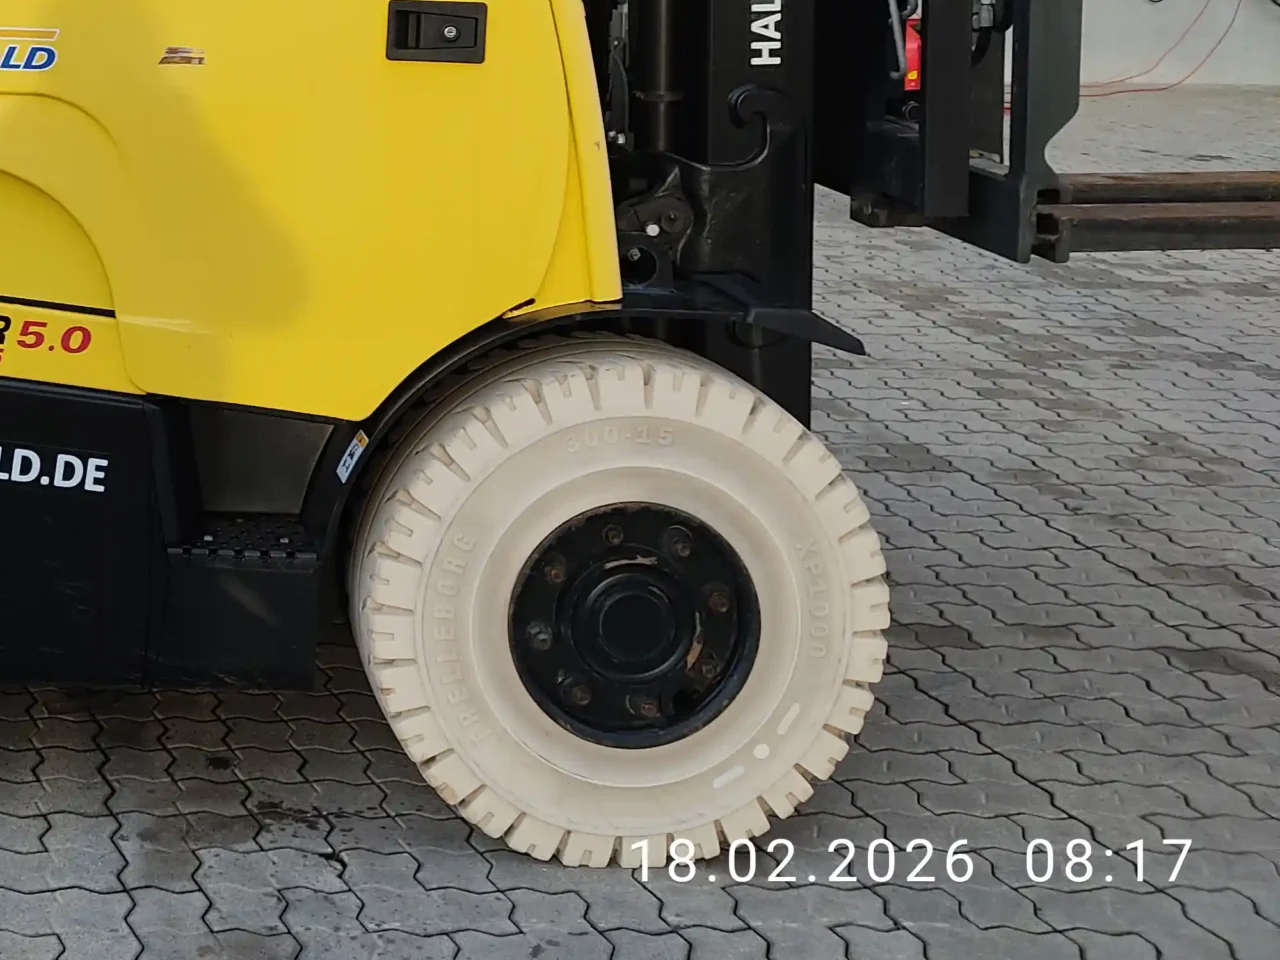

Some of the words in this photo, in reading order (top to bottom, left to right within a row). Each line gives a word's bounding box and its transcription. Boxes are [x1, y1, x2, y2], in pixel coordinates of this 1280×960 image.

[16, 319, 92, 354] 5.0
[564, 424, 674, 453] 300-15
[433, 532, 495, 748] TRELLEBORG
